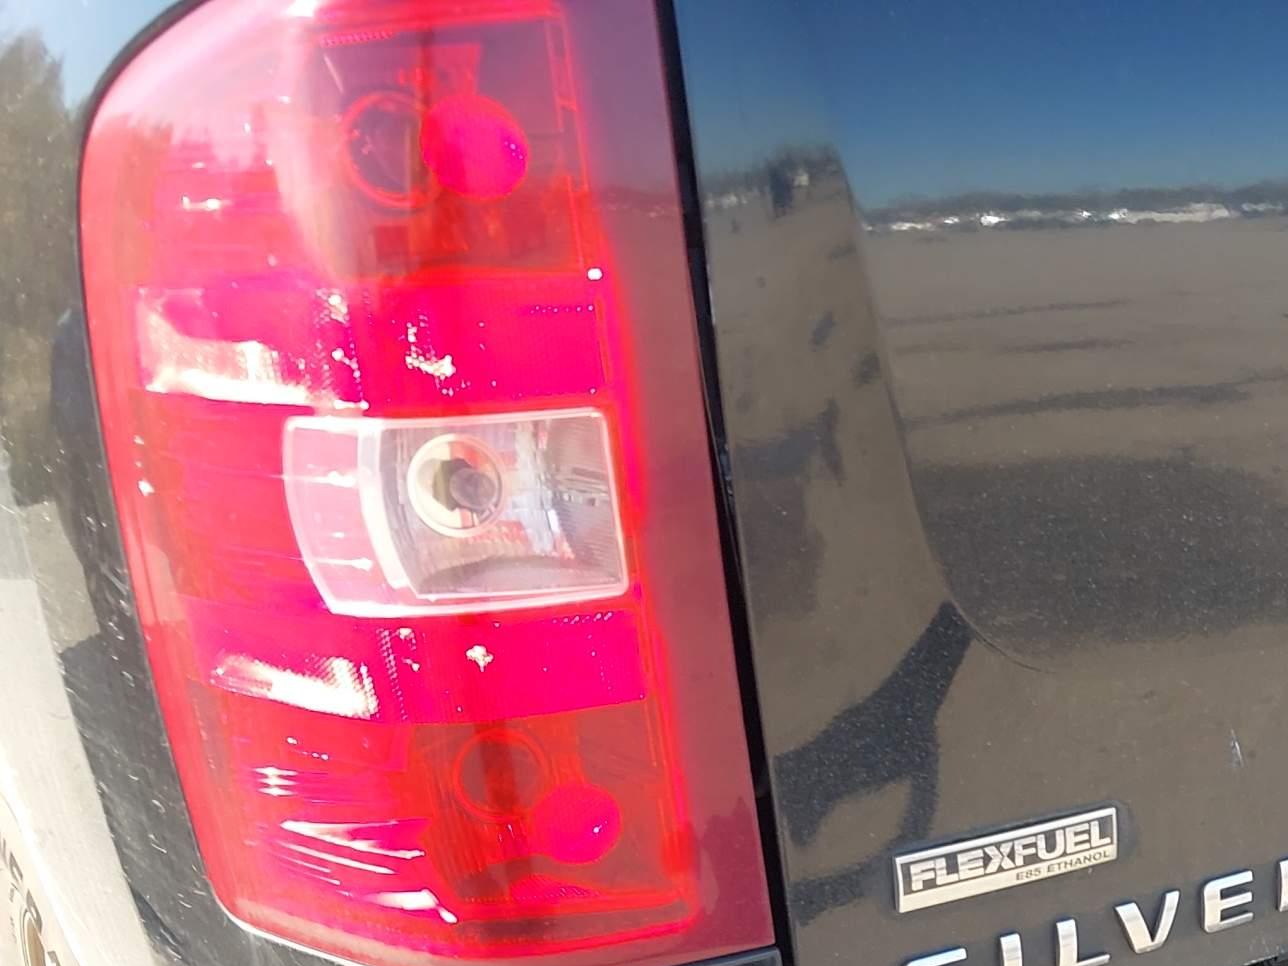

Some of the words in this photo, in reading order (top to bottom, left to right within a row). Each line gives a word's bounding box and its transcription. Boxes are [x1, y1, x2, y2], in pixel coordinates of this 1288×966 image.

[909, 819, 1112, 891] FLEXFUEL
[1014, 868, 1042, 882] E85
[1046, 850, 1112, 875] ETHANOL
